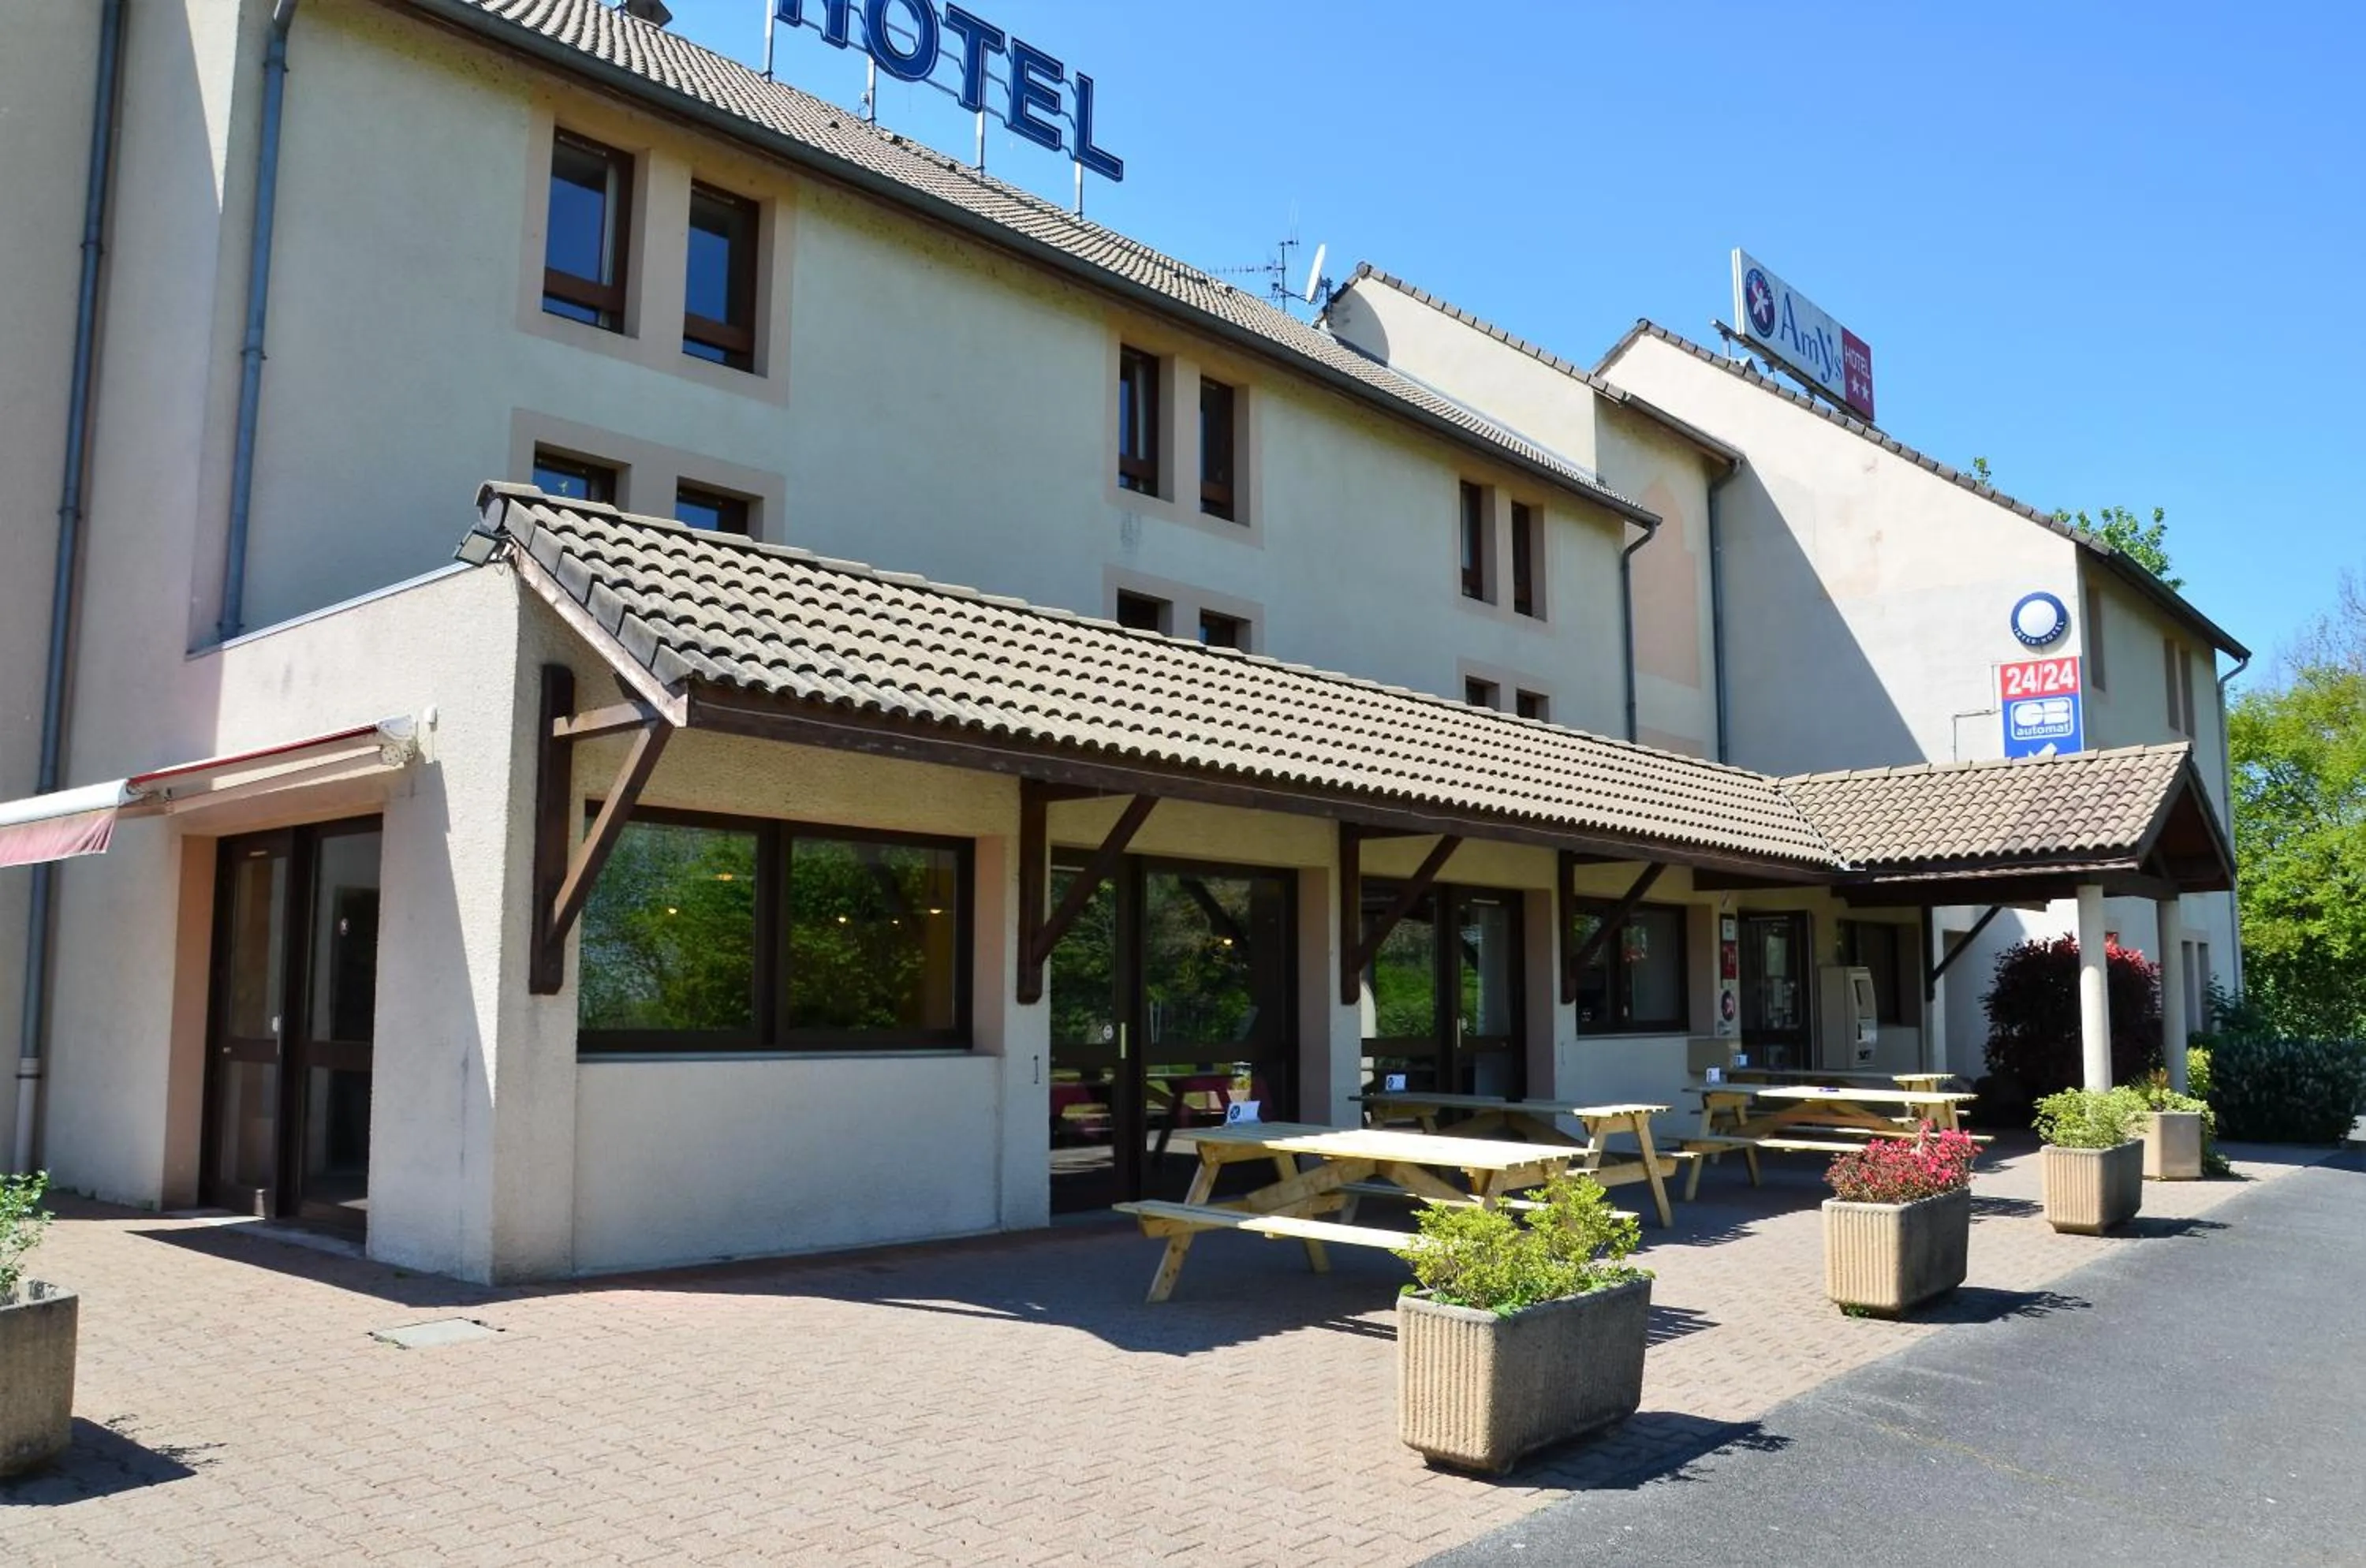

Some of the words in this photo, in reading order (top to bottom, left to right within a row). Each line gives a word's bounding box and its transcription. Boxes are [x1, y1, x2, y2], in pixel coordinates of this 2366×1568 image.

[1845, 345, 1870, 379] HOTEL
[2006, 660, 2076, 695] 24/24
[2017, 723, 2069, 736] automat
